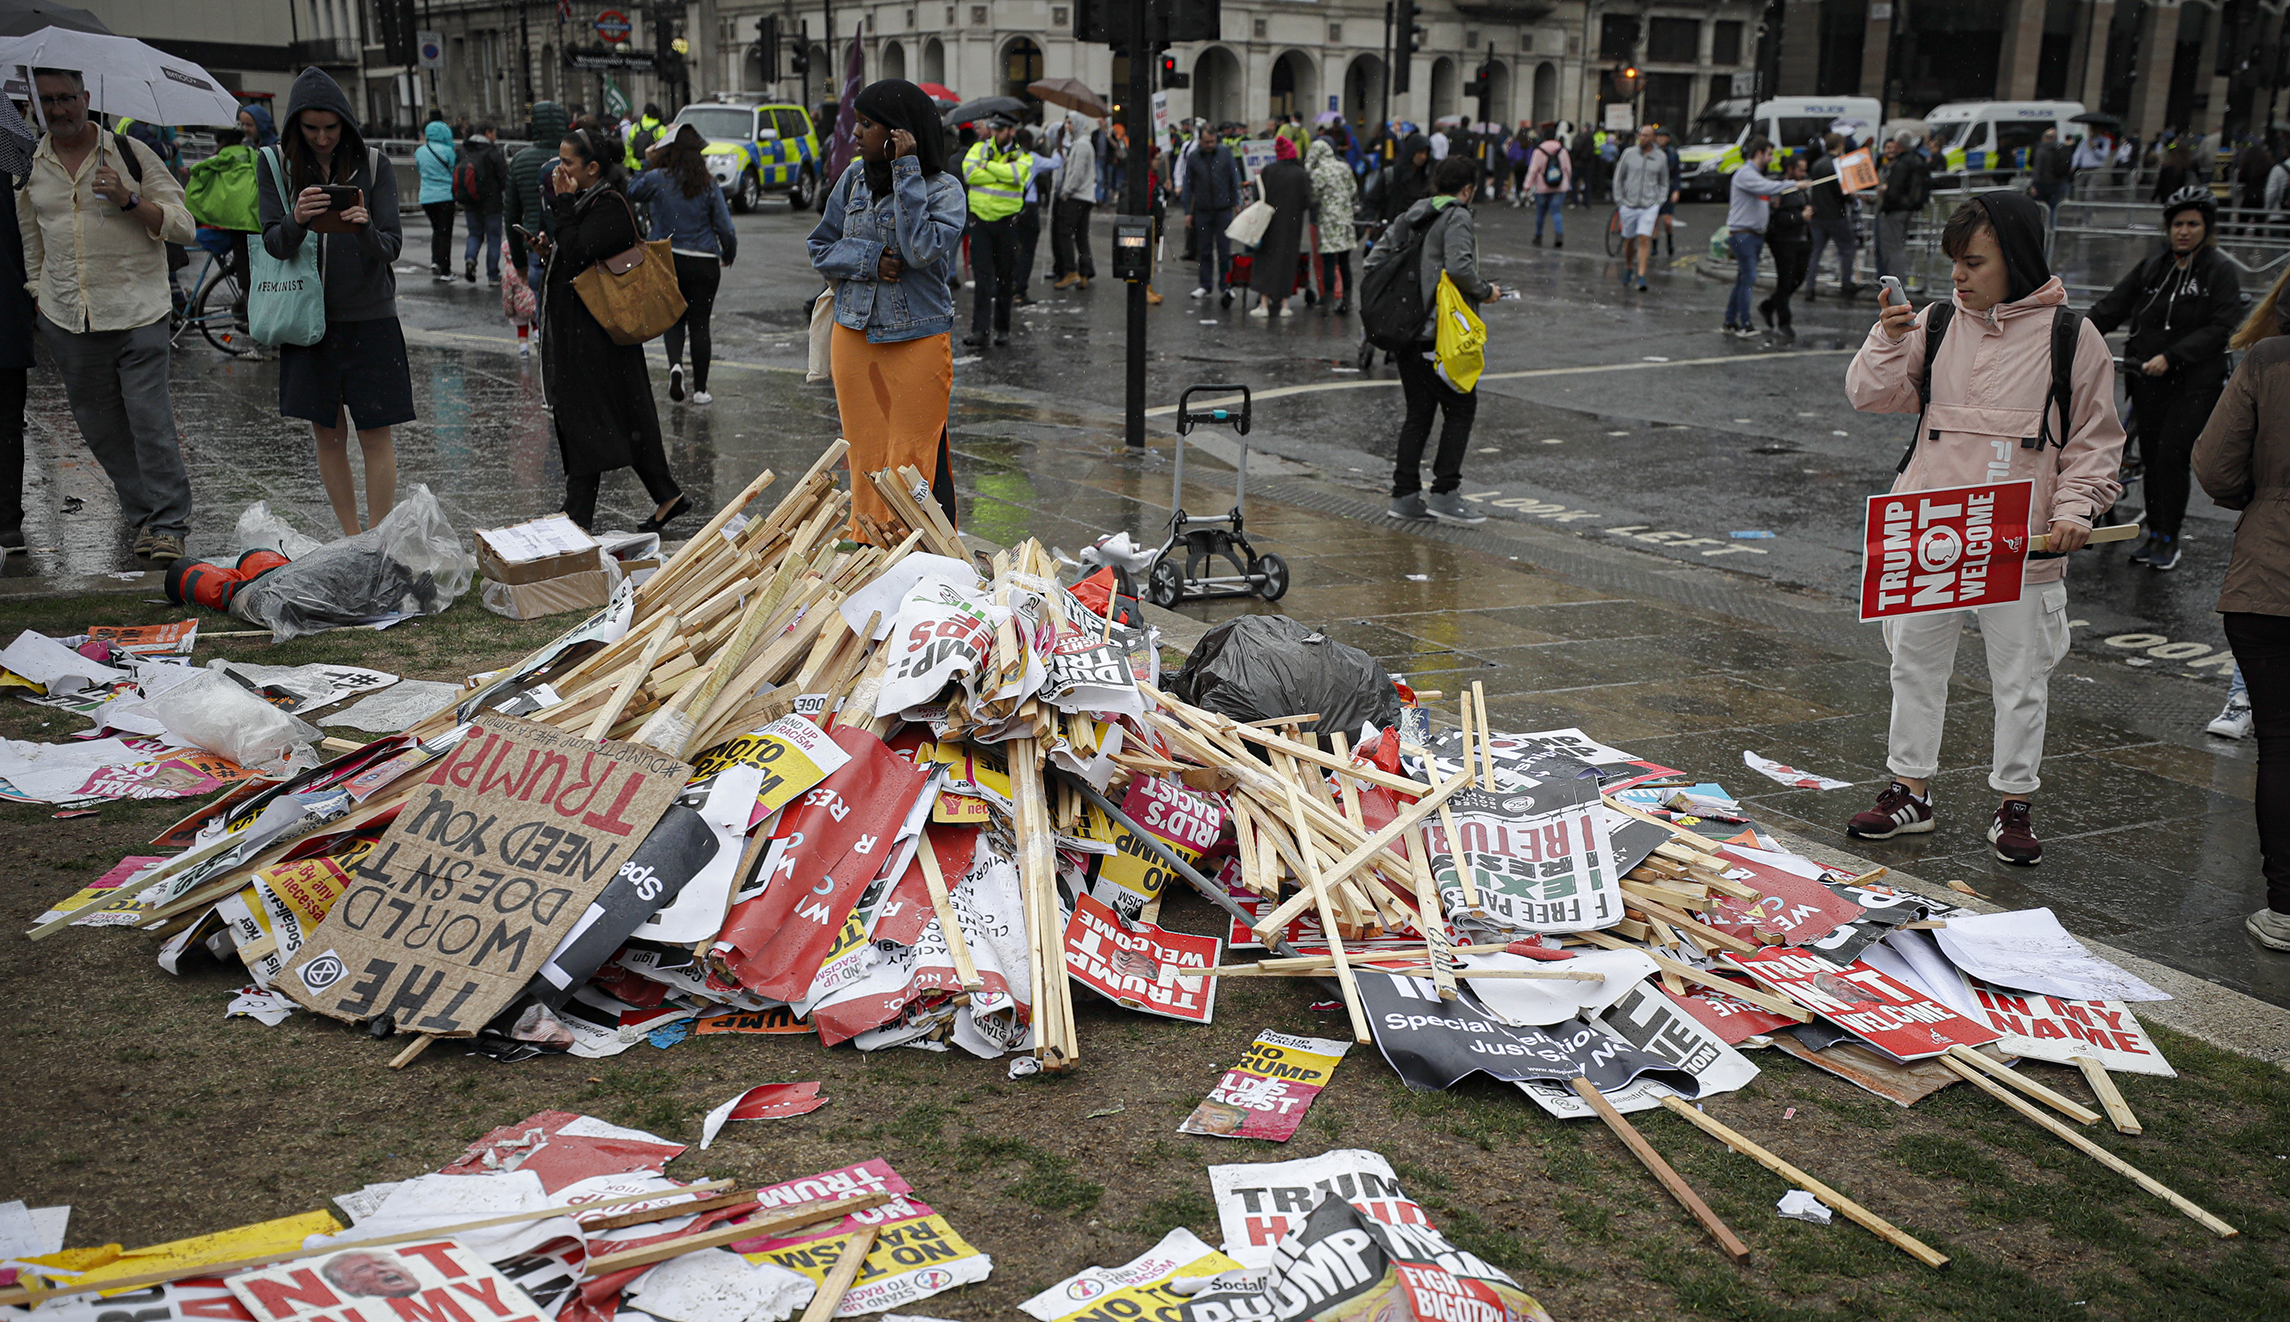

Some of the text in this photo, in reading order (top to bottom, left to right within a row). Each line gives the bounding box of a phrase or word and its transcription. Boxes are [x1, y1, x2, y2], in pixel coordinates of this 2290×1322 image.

[1118, 236, 1146, 248] WAIT
[1986, 440, 2013, 484] FIL
[1461, 491, 1768, 556] LOOK LEFT
[1878, 501, 1913, 611] TRUMP
[1911, 498, 1963, 607] NOT
[1959, 491, 1995, 601] WELCOME
[747, 738, 785, 763] TO
[776, 725, 815, 751] RACISM
[802, 727, 819, 740] UP
[425, 726, 646, 836] TRUMP!
[1140, 776, 1221, 827] RACIST
[405, 789, 497, 856] YOU
[1422, 820, 1571, 862] RETUR
[500, 821, 617, 882] NEED
[964, 856, 1008, 885] MIGRA
[282, 876, 327, 923] necessa
[298, 863, 336, 901] By any
[360, 842, 573, 926] DOESN'T
[343, 885, 533, 972] WORLD
[1522, 899, 1582, 924] FREE
[1078, 909, 1206, 967] WELCOME
[1066, 951, 1198, 1010] TRUMP
[1743, 955, 1855, 980] TRUM
[336, 958, 479, 1031] THE
[1974, 989, 2122, 1030] IN MY
[1384, 1013, 1495, 1033] Special
[1985, 1010, 2151, 1055] NAME
[1237, 1056, 1322, 1081] RUMP
[1470, 1039, 1535, 1057] Just
[757, 1167, 886, 1209] TRUM
[1231, 1172, 1411, 1213] TRUM
[851, 1194, 917, 1225] NO
[892, 1240, 959, 1265] NO
[1125, 1259, 1177, 1287] RACISM
[1137, 1258, 1155, 1273] UP
[840, 1278, 908, 1308] TO RACIS
[868, 1287, 916, 1308] STAND
[1210, 1277, 1268, 1292] Sociali
